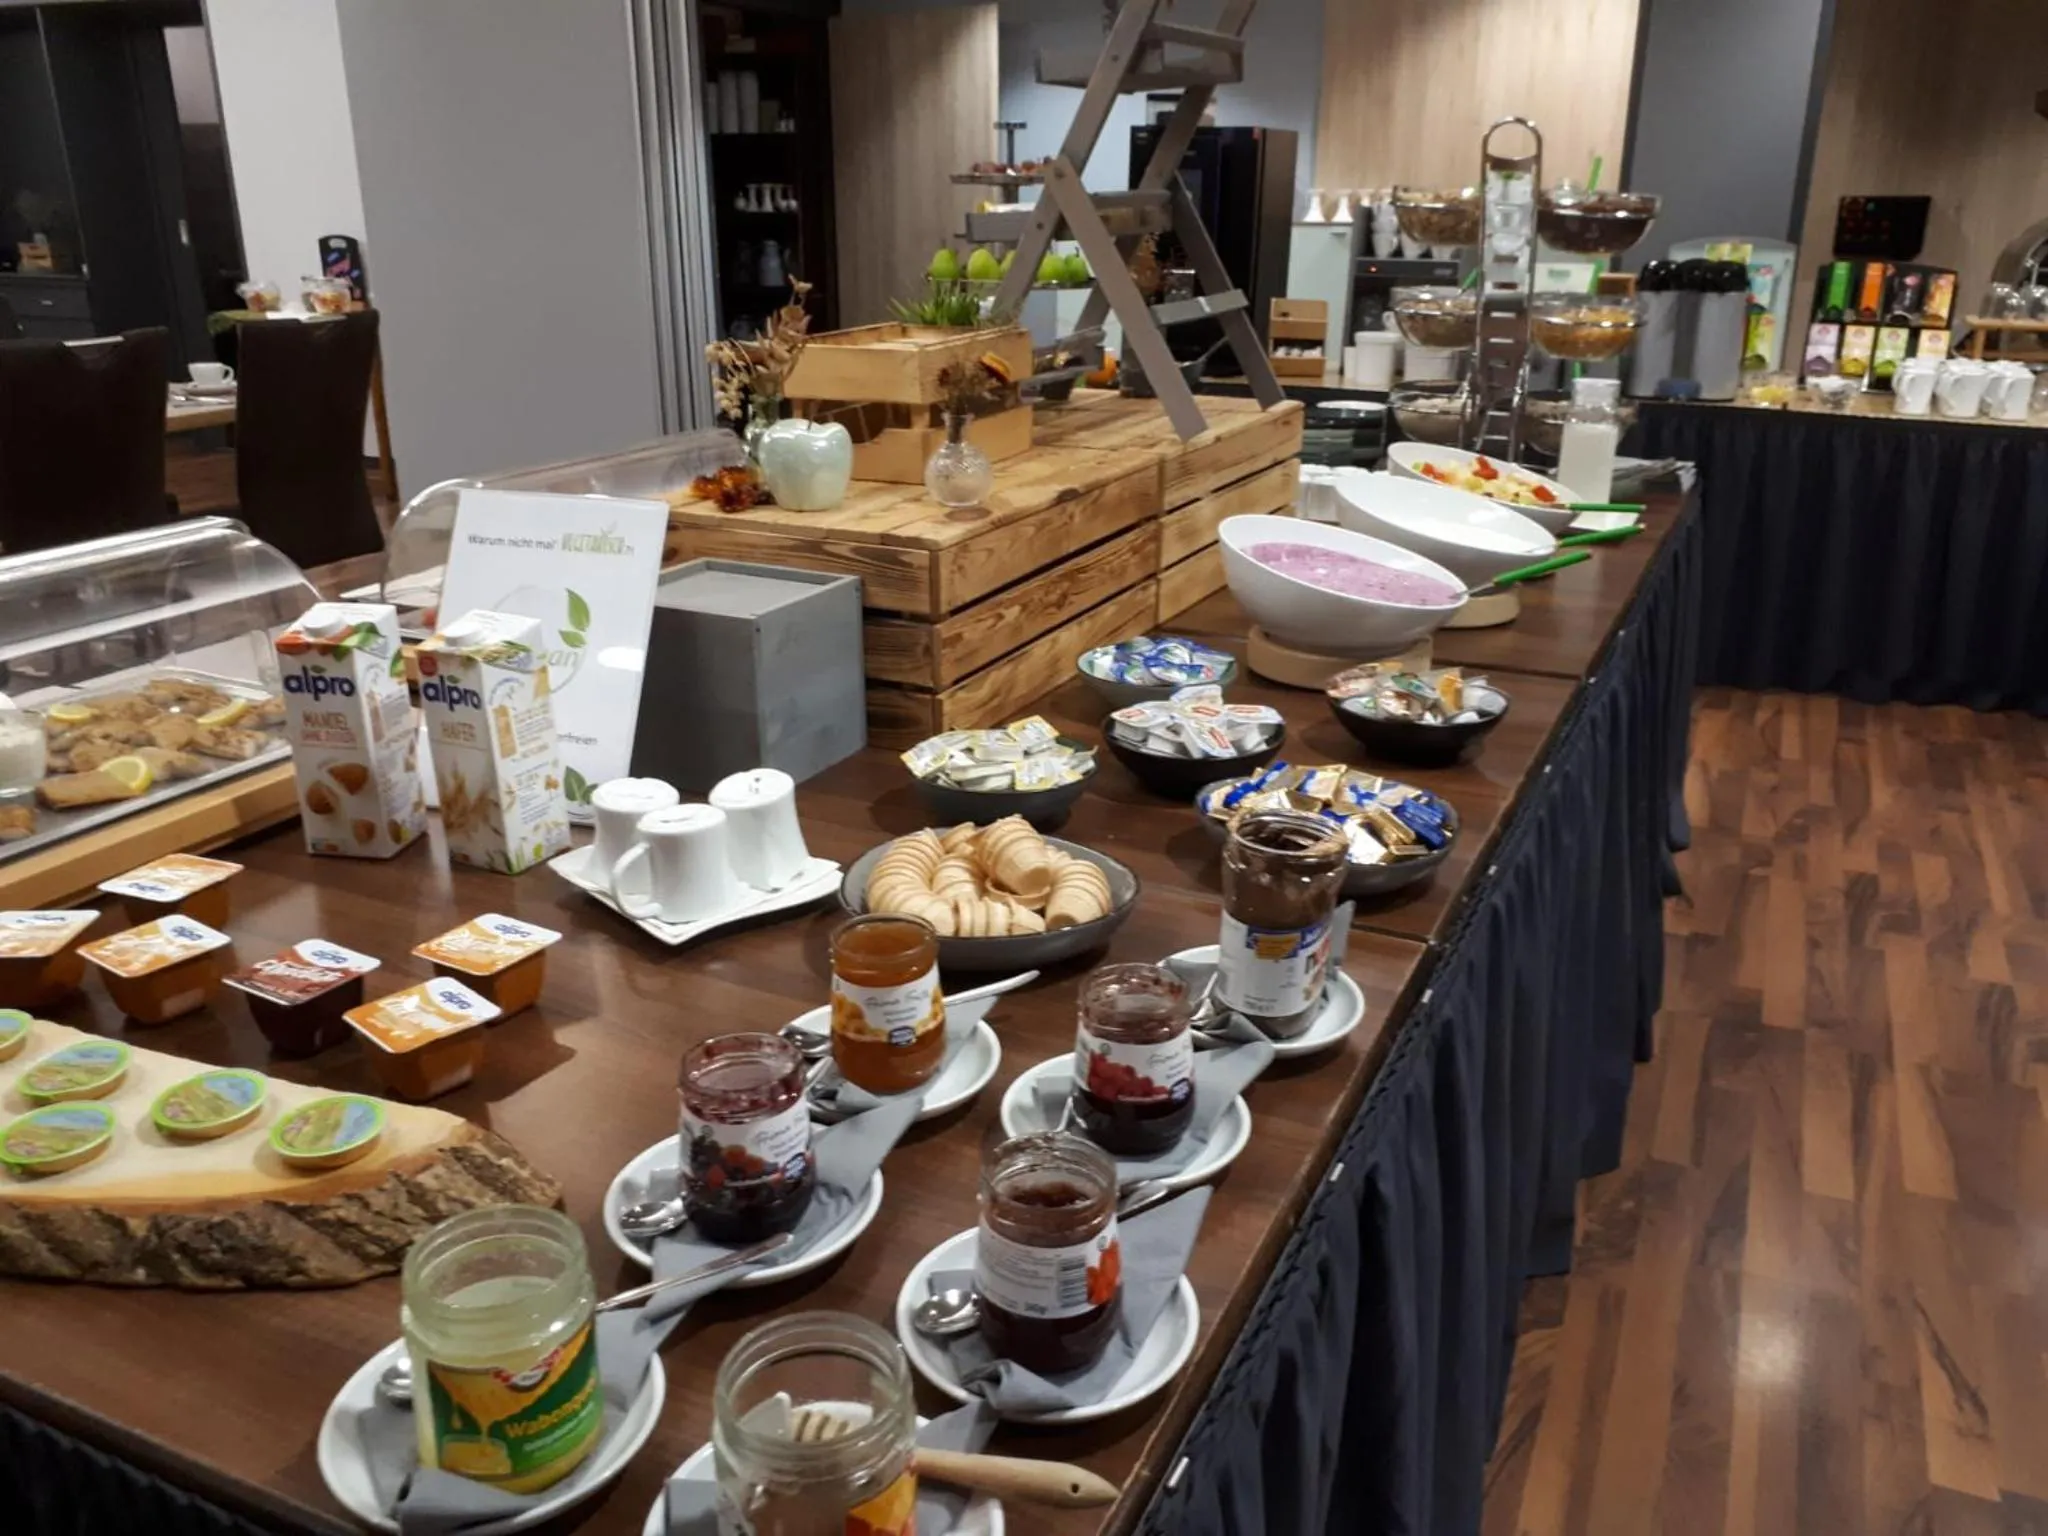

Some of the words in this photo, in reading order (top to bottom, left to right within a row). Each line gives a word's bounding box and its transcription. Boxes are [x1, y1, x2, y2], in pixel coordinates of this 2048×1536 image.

[283, 664, 356, 702] alpro
[422, 674, 483, 712] alpro
[493, 922, 533, 939] alpro
[310, 949, 349, 964] alpro
[438, 990, 473, 1010] alpro
